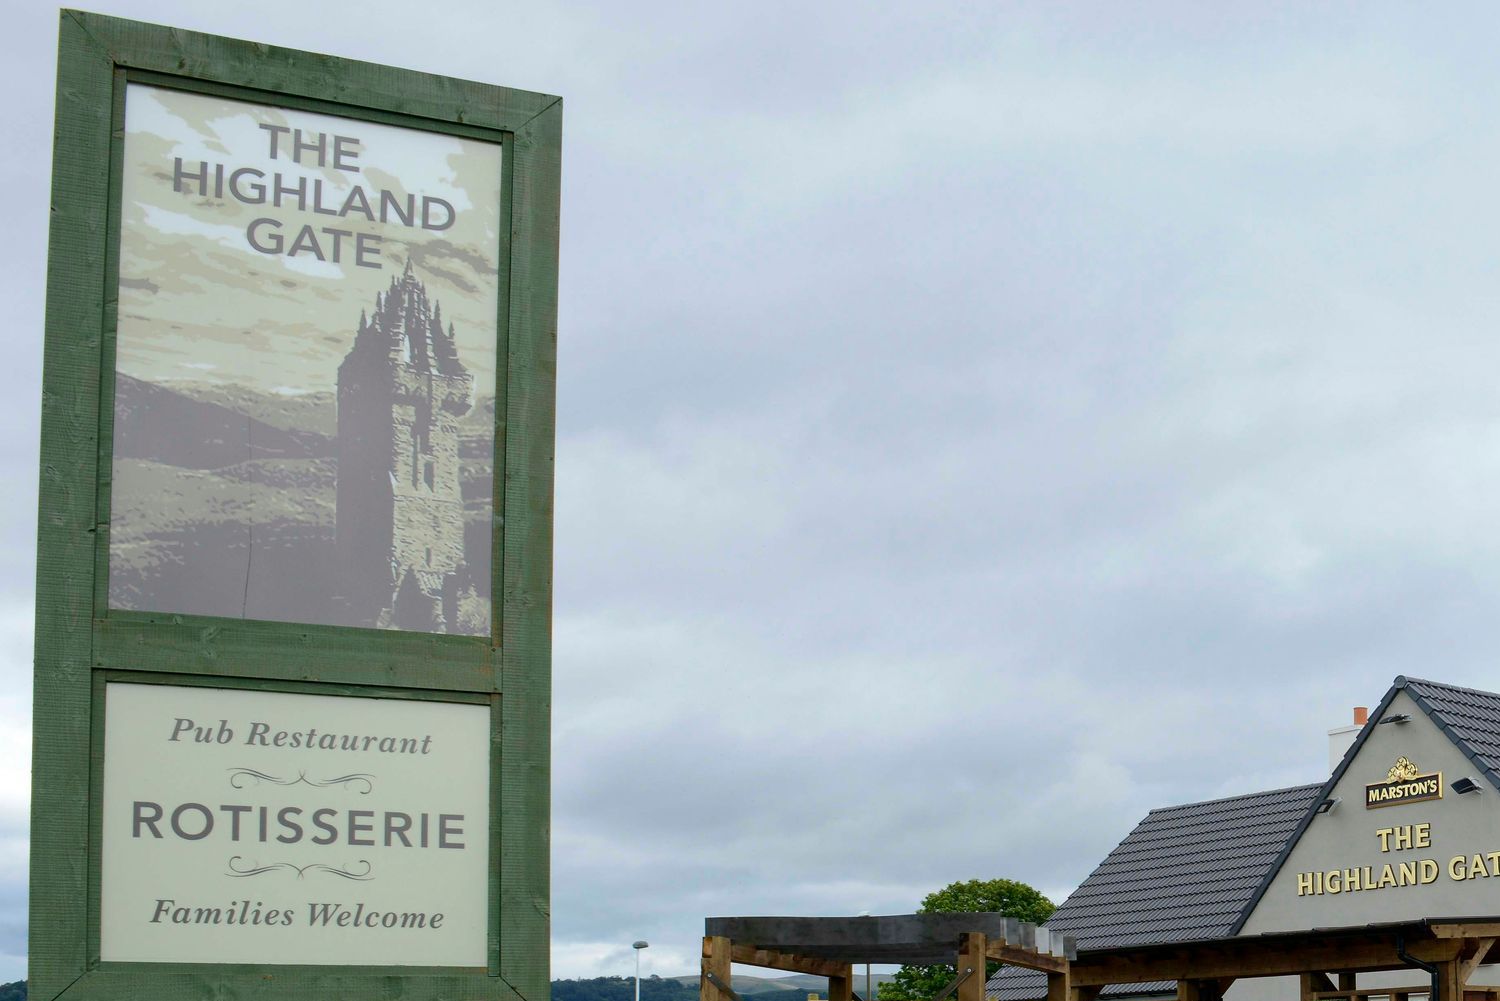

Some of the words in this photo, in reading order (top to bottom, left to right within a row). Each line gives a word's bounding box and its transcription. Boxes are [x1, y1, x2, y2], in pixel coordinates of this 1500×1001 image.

[258, 122, 361, 173] THE
[172, 157, 457, 231] HIGHLAND
[245, 217, 383, 270] GATE
[168, 718, 234, 745] Pub
[244, 721, 433, 756] Restaurant
[1368, 779, 1438, 802] MARSTON'S
[131, 801, 466, 850] ROTISSERIE
[1376, 822, 1432, 852] THE
[1297, 858, 1439, 896] HIGHLAND
[148, 899, 295, 926] Families
[305, 903, 445, 929] Welcome
